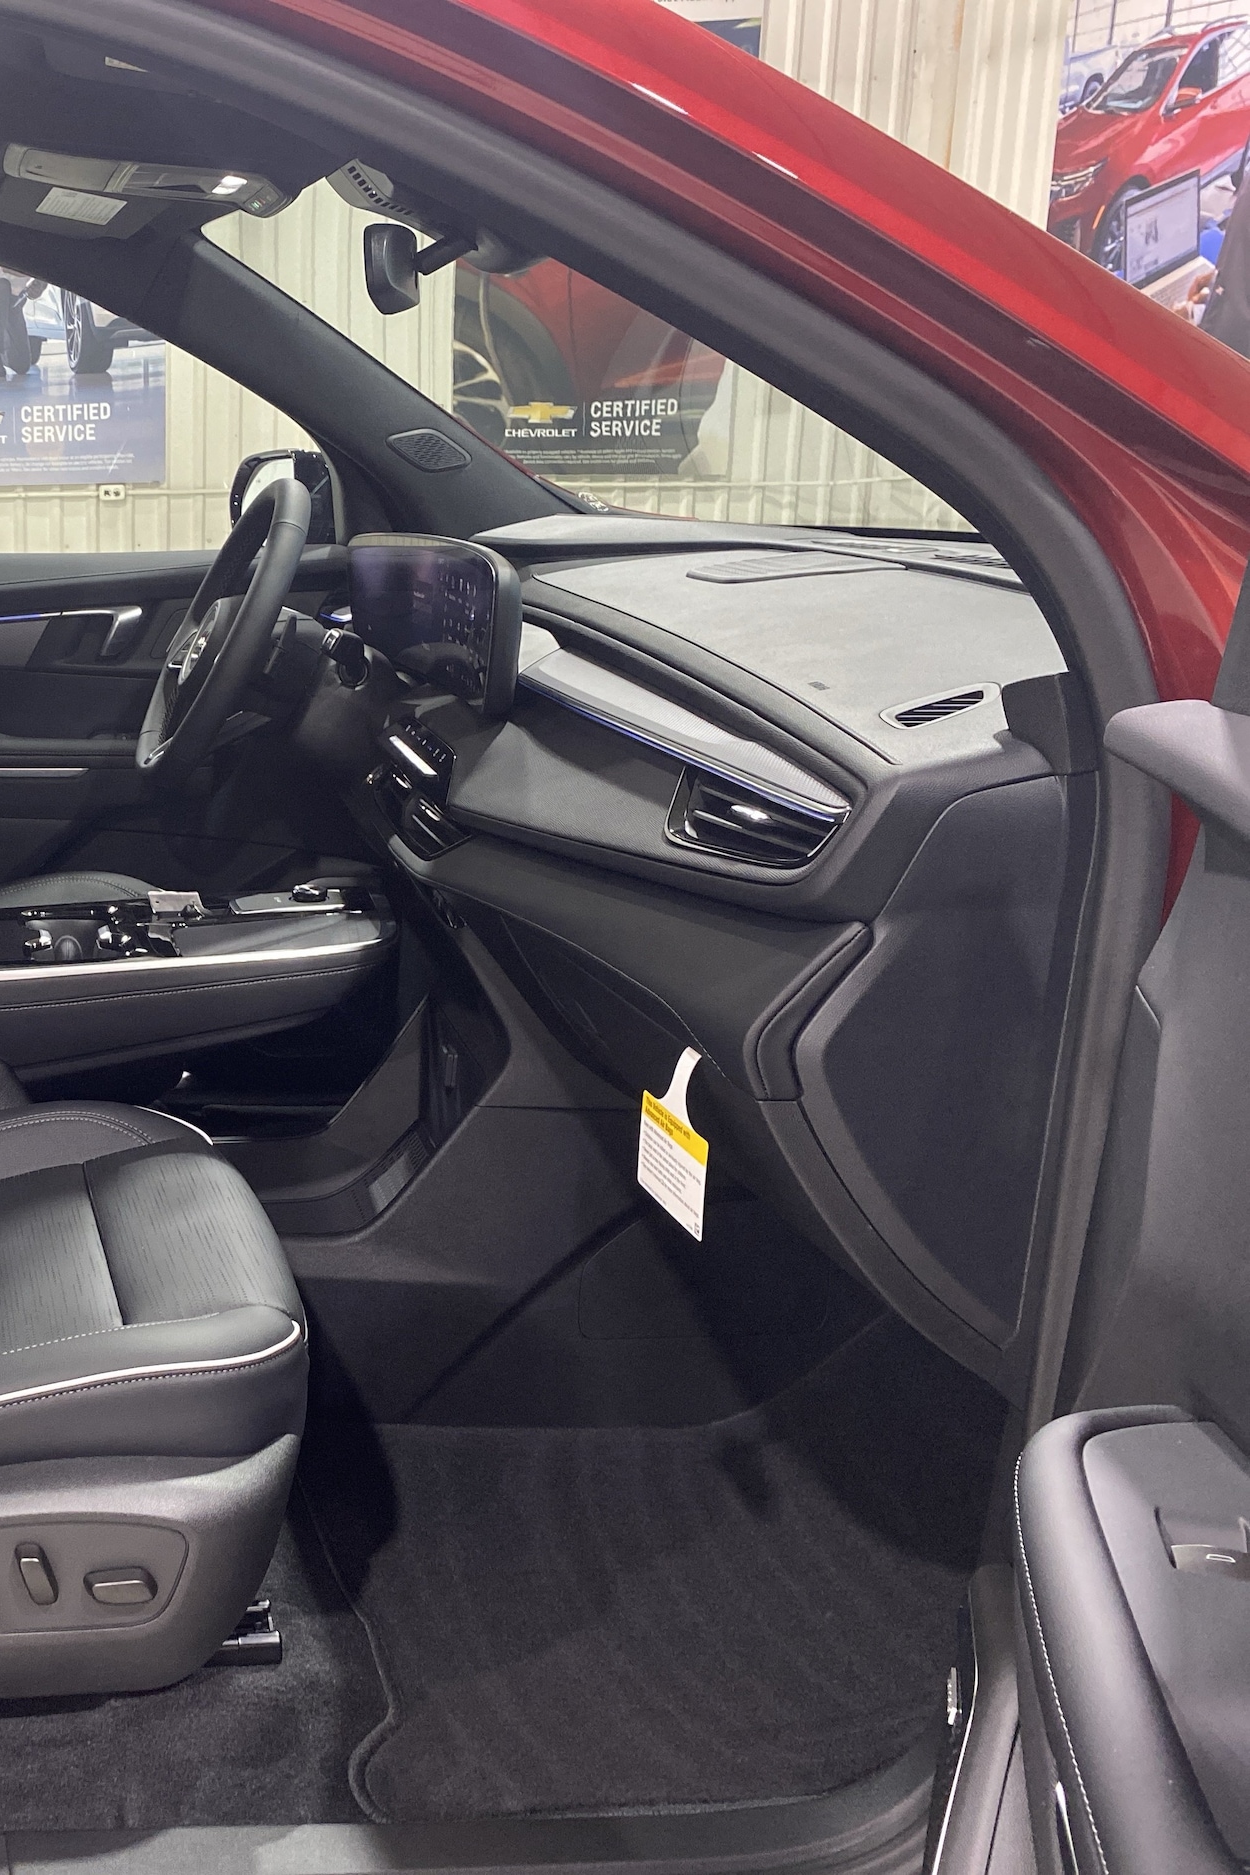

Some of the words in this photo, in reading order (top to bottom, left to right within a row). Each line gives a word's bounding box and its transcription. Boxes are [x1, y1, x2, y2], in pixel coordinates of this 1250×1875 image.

[21, 402, 111, 423] CERTIFIED
[590, 398, 678, 418] CERTIFIED
[21, 423, 96, 443] SERVICE
[504, 428, 578, 438] CHEVROLET
[590, 419, 662, 438] SERVICE
